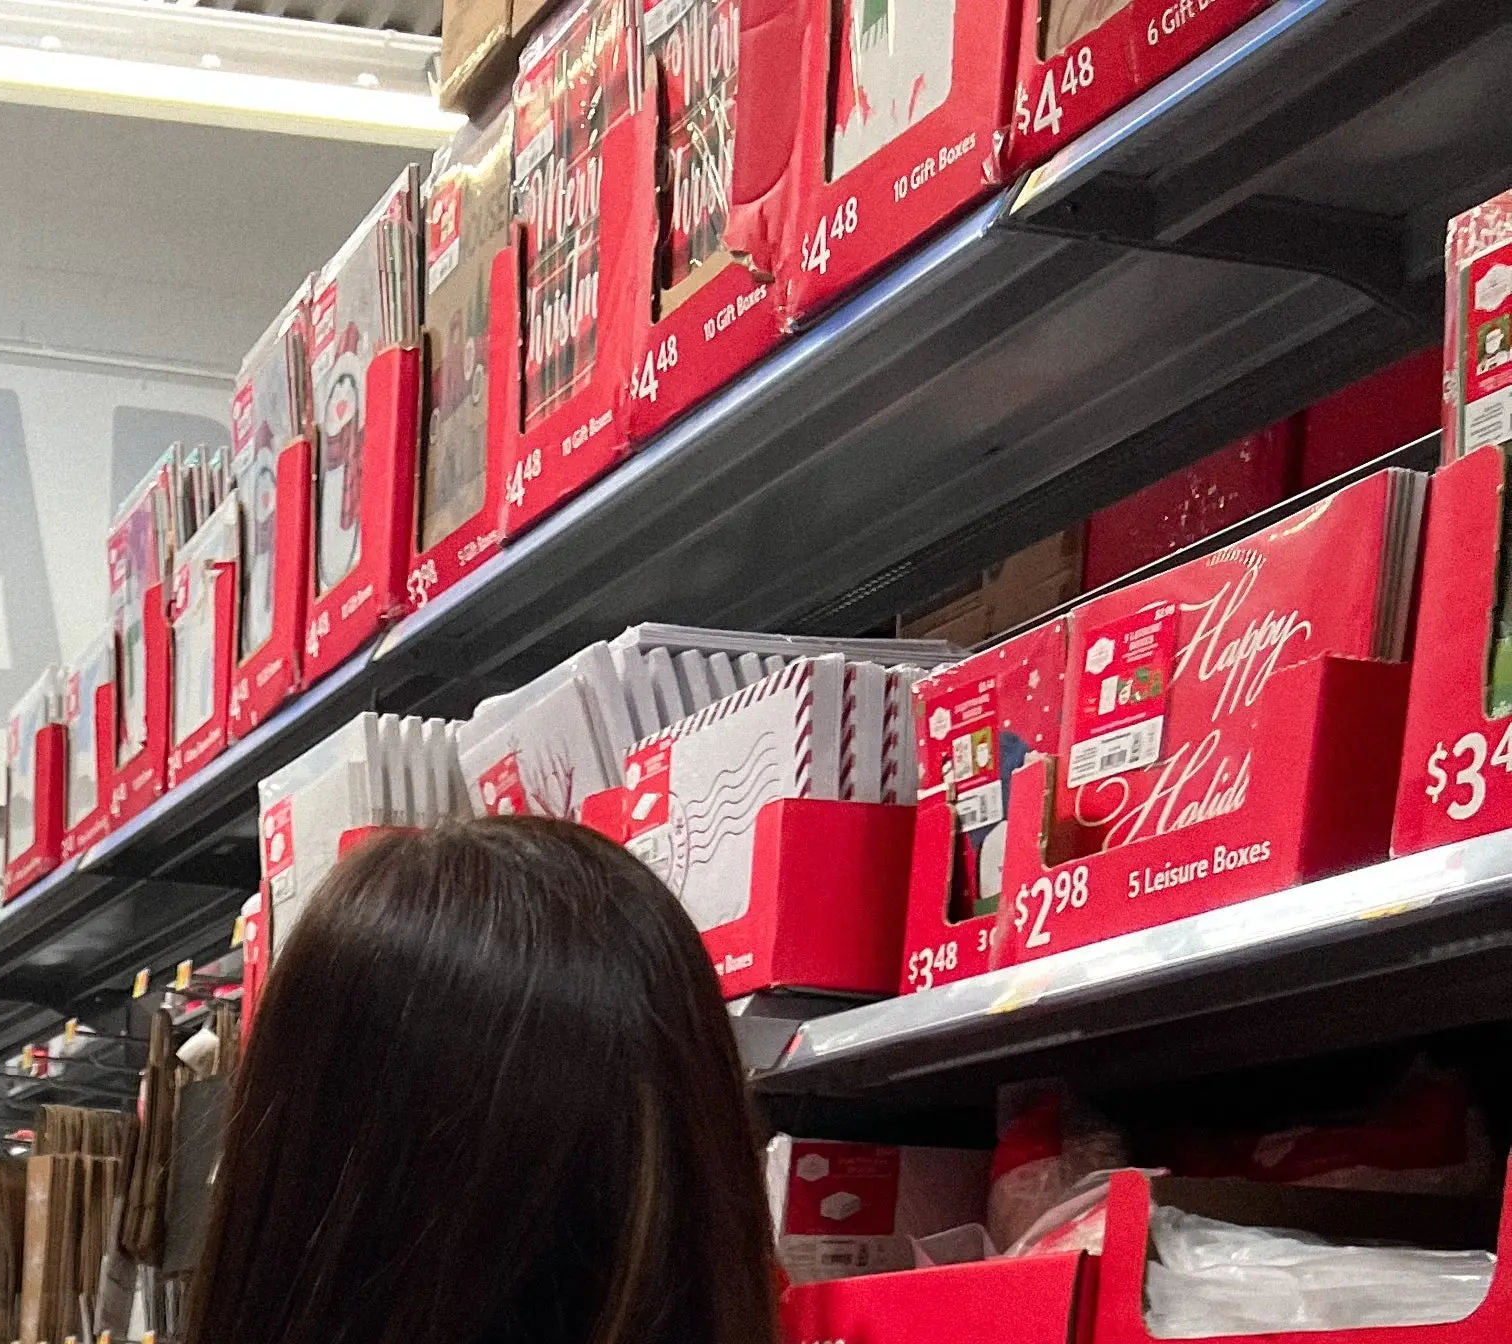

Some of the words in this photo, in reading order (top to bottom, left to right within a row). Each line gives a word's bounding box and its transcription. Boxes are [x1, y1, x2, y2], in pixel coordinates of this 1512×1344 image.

[1147, 18, 1159, 45] 6
[1016, 46, 1095, 136] $448
[893, 175, 908, 203] 10
[910, 157, 936, 190] Gift
[938, 132, 976, 172] Boxes
[800, 196, 858, 275] $448
[703, 317, 716, 342] 10
[629, 334, 679, 404] $448
[1171, 565, 1312, 722] Happy
[1127, 870, 1141, 899] 5
[1143, 861, 1208, 895] Leisure
[1211, 839, 1272, 875] Boxes
[1013, 865, 1089, 949] $298
[908, 940, 958, 994] $348
